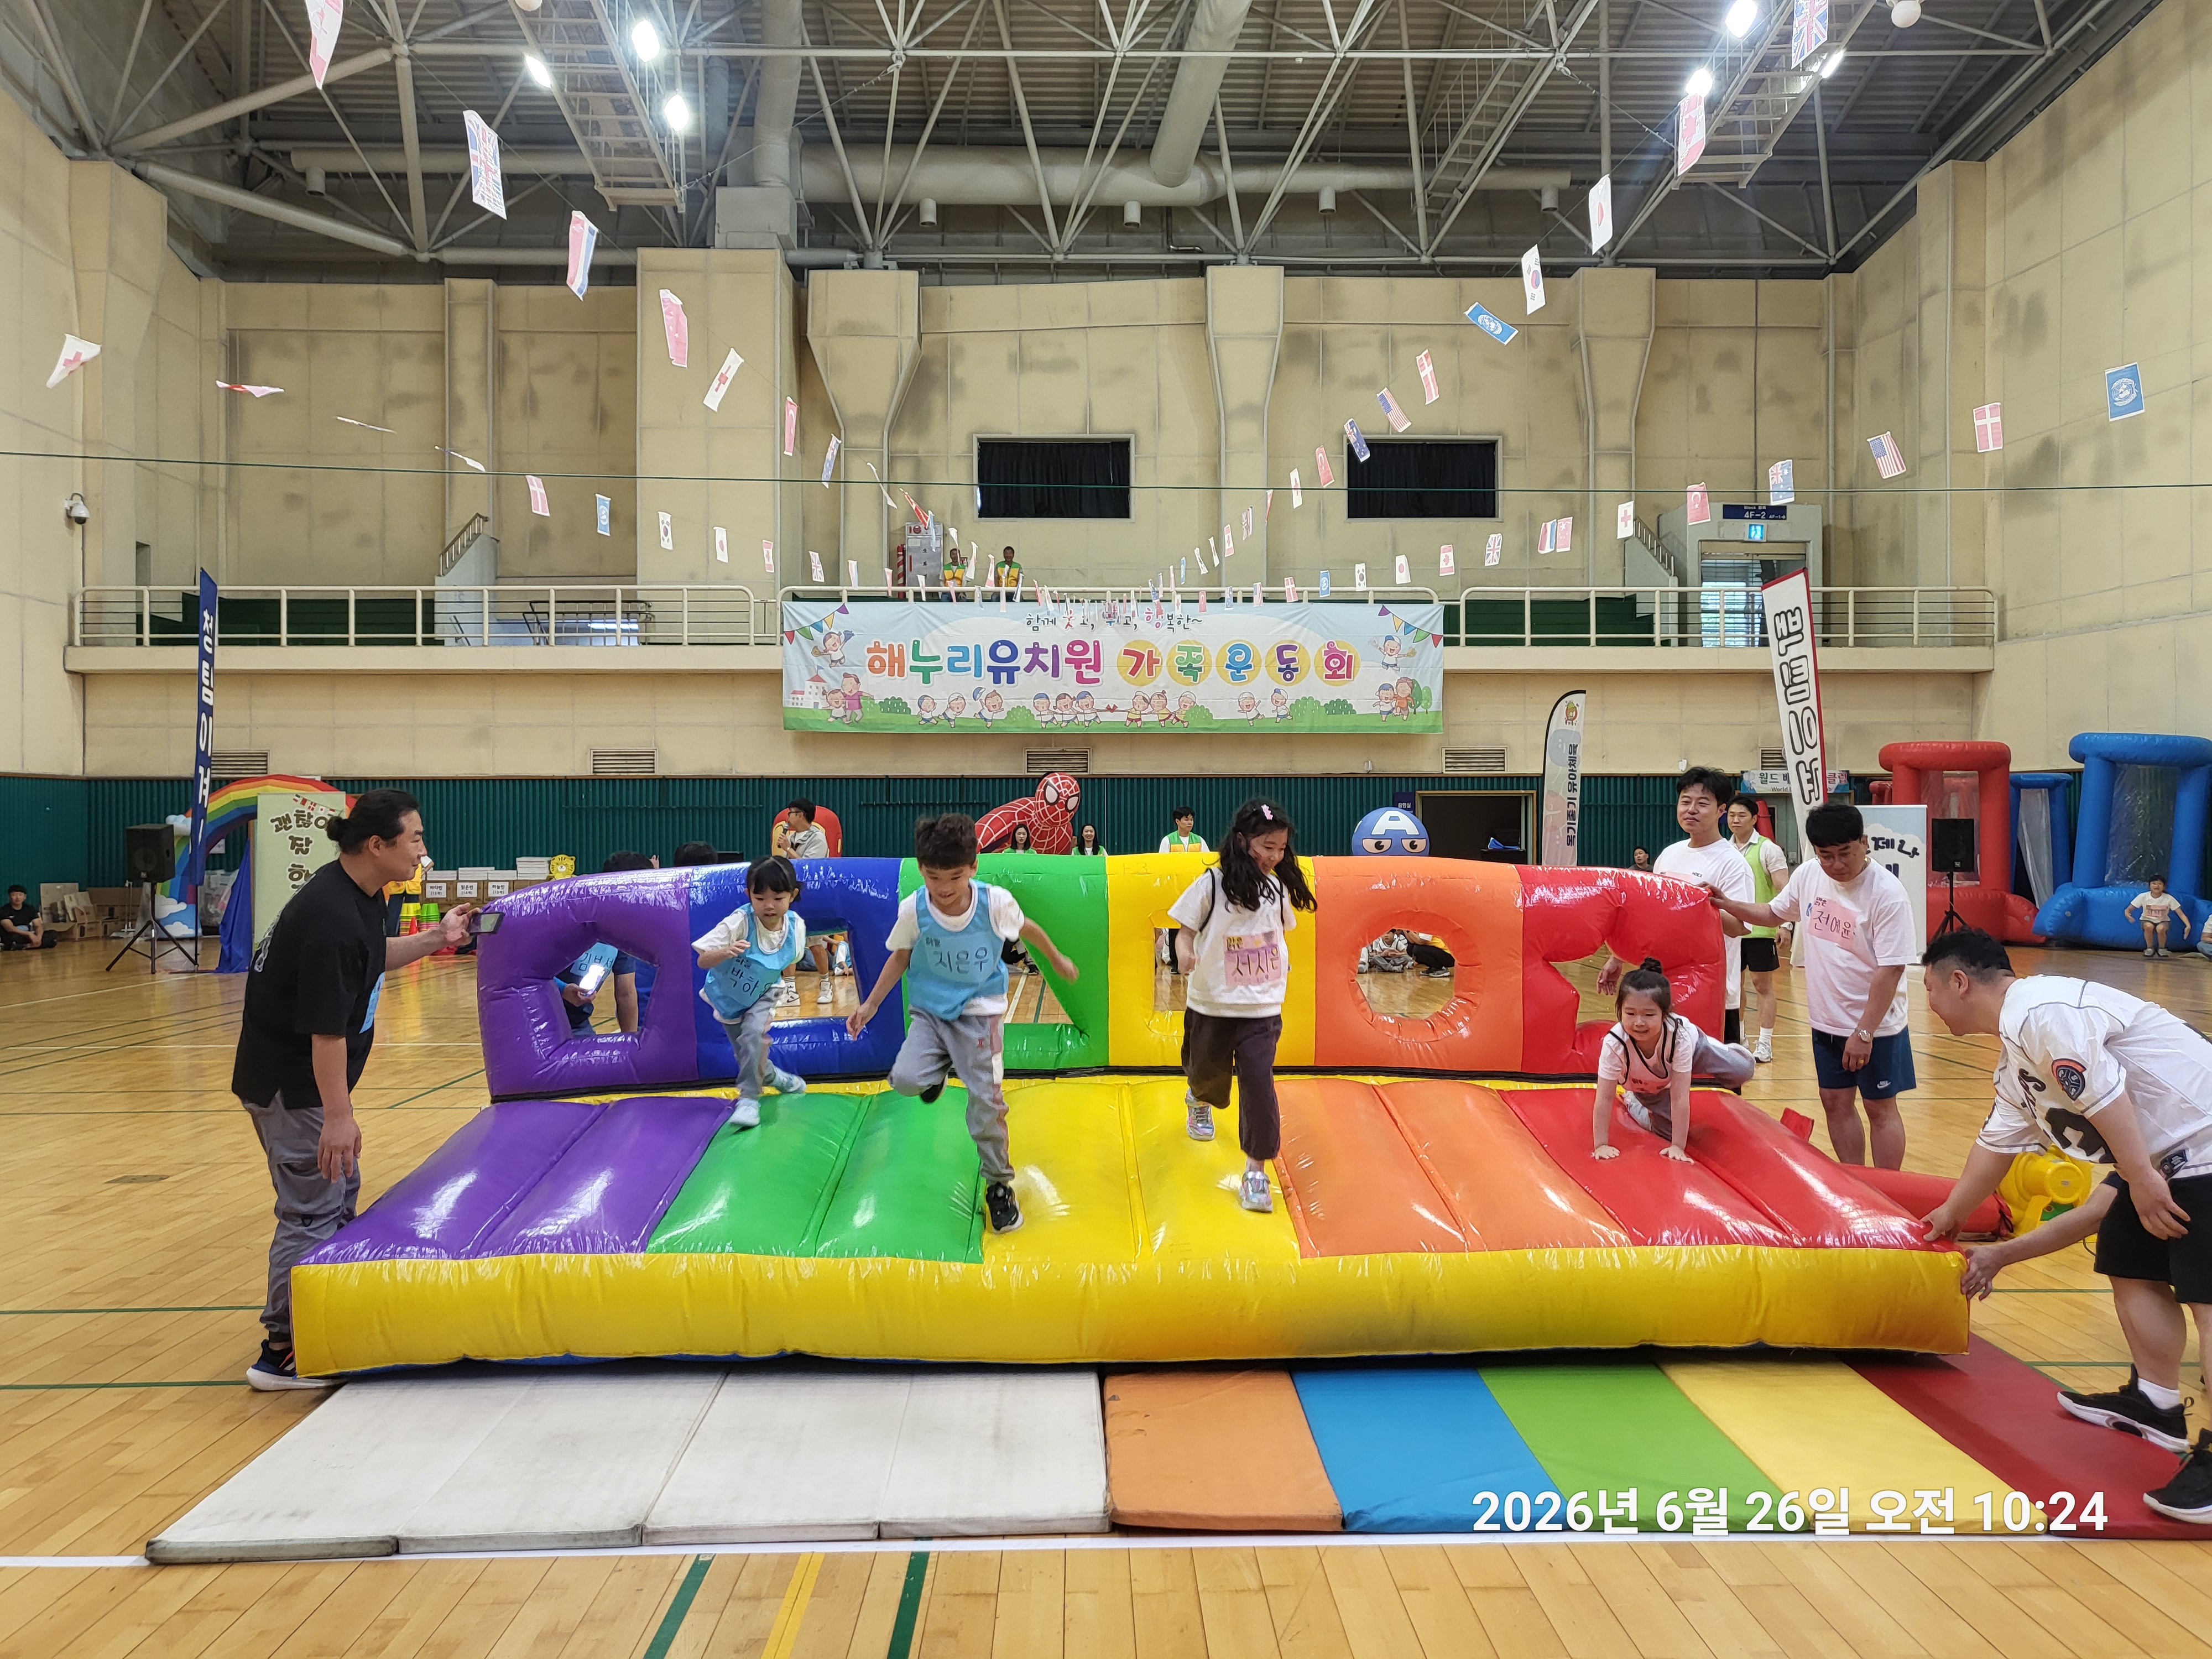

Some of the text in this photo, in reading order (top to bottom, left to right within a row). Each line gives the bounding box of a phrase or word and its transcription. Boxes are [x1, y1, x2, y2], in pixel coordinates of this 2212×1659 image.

[1025, 613, 1056, 632] 함께
[866, 639, 1102, 685] 해누리유치원
[1567, 743, 1578, 794] 유아체육
[1758, 772, 1780, 785] 월드
[1827, 771, 1848, 785] 클럽
[288, 835, 313, 855] 잘
[1865, 836, 1920, 859] 제나
[1813, 910, 1851, 940] 전예윤
[933, 946, 989, 974] 지은우
